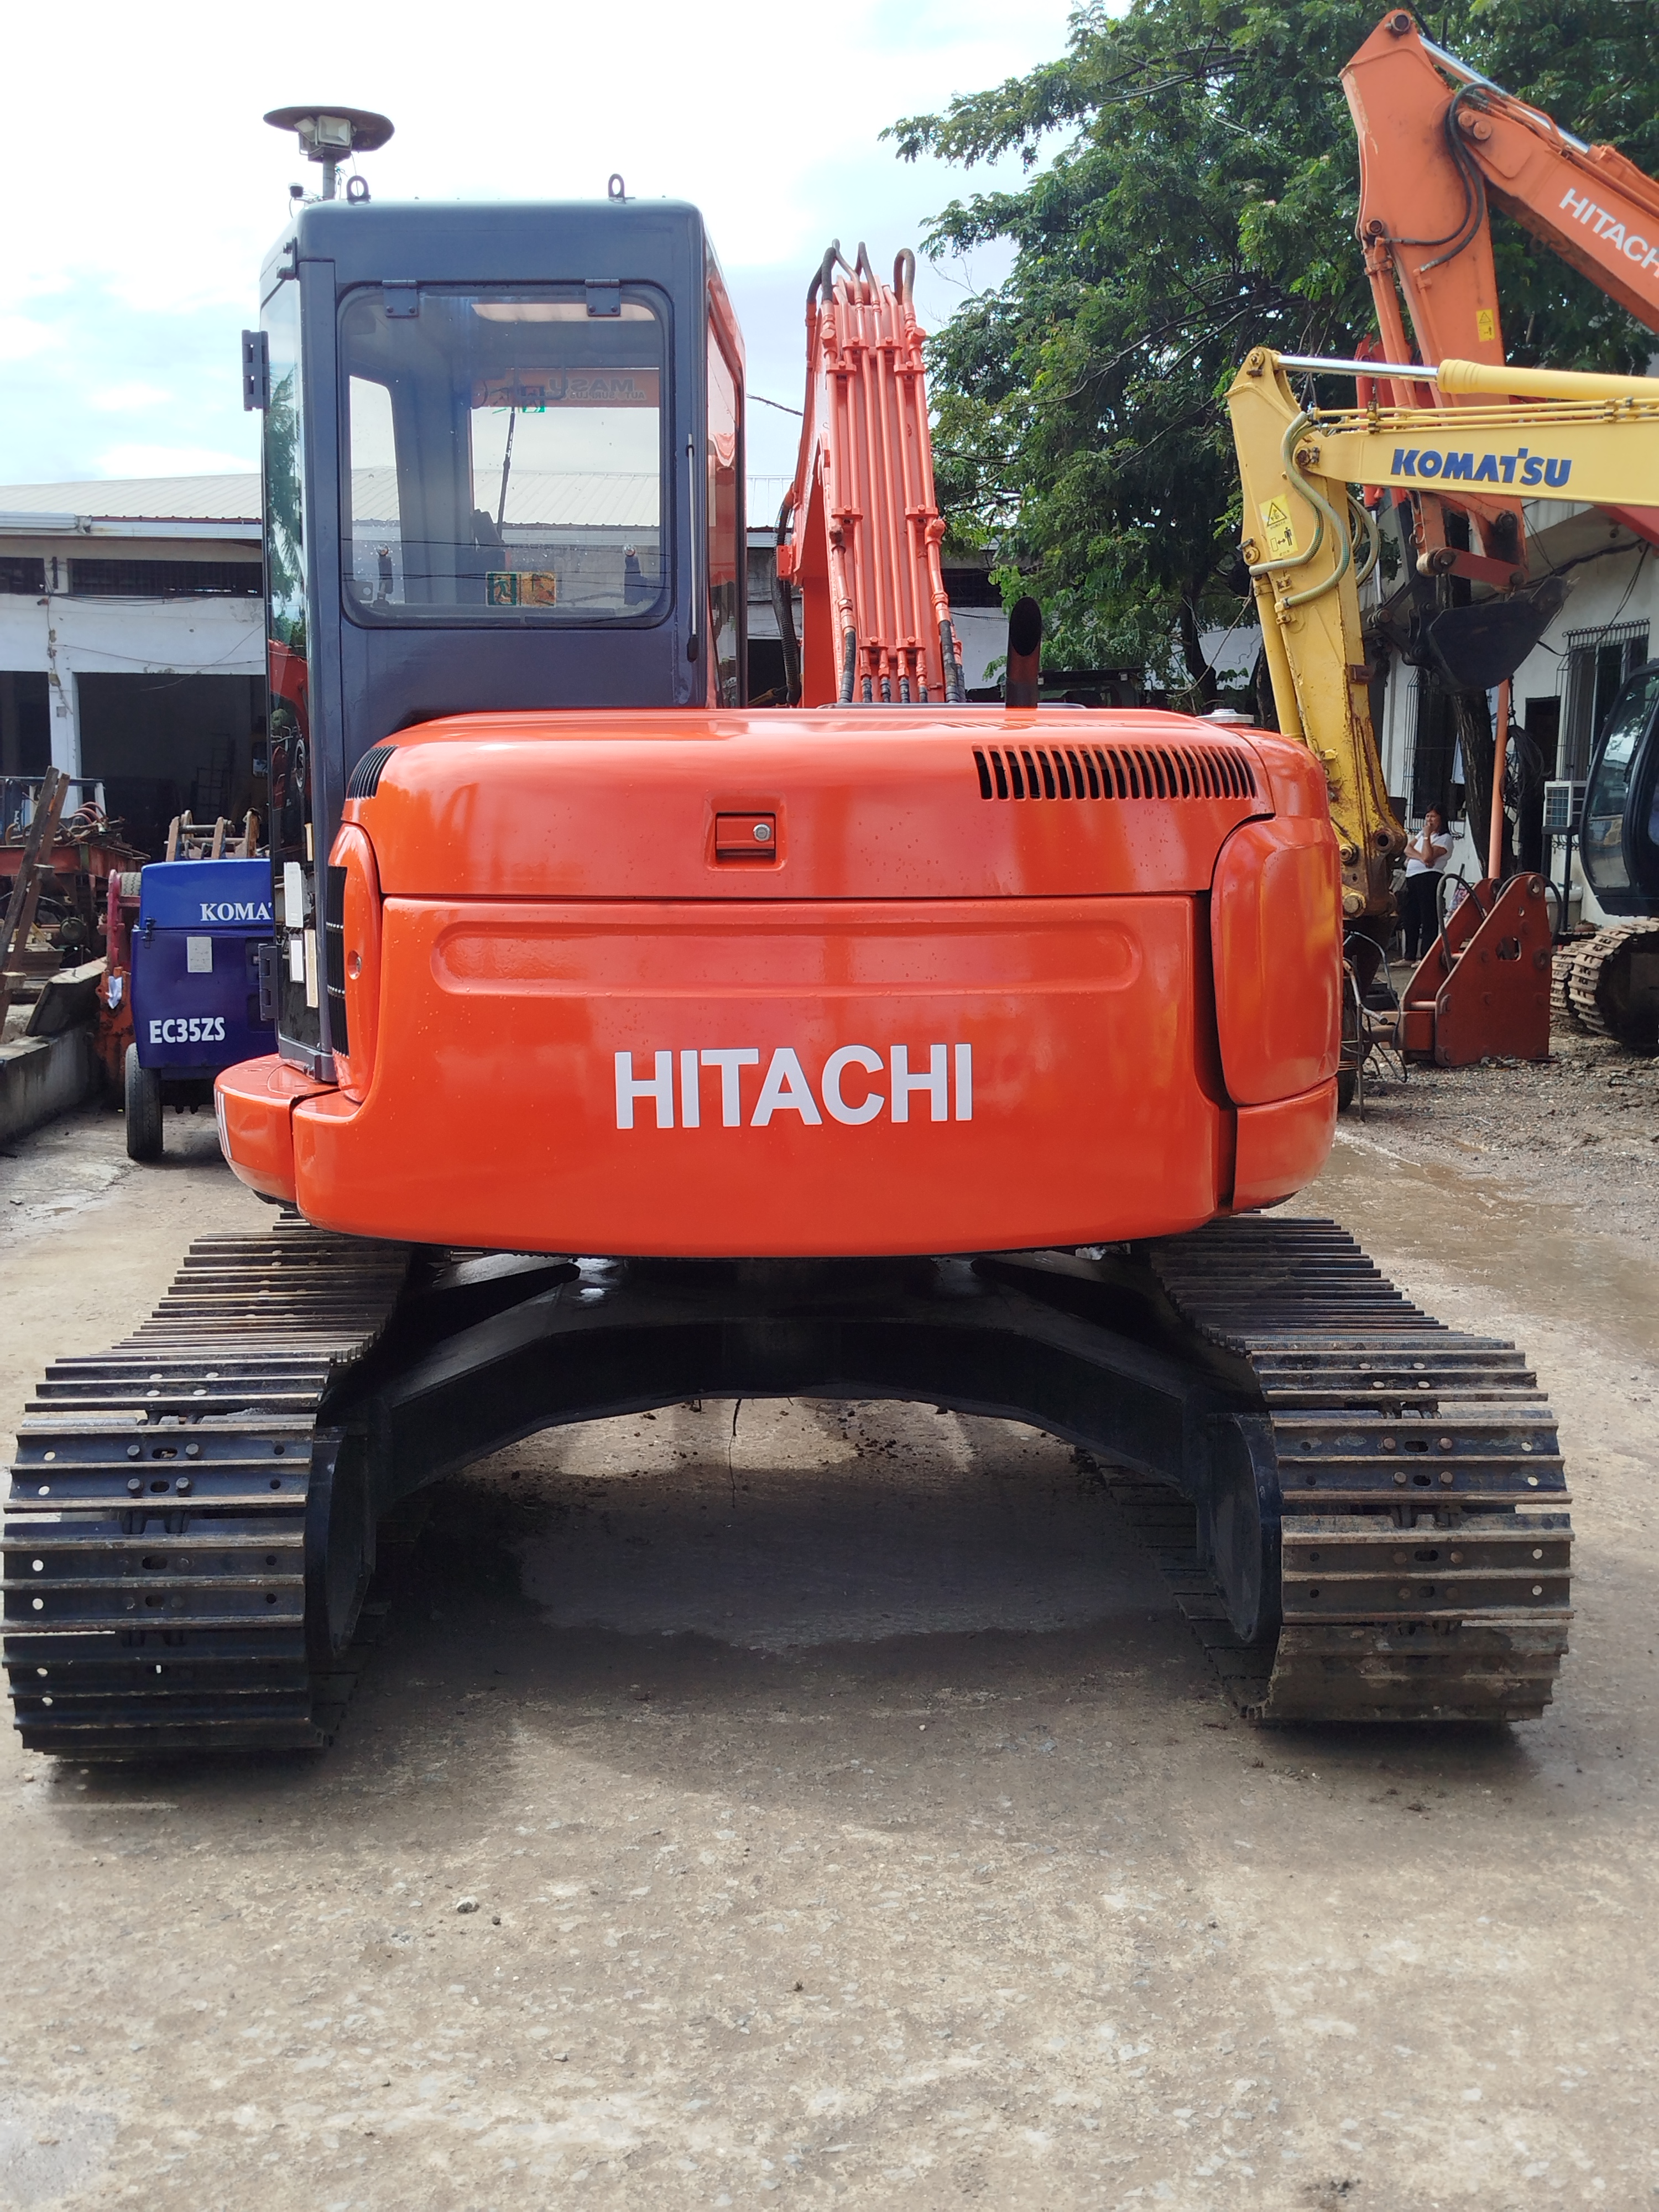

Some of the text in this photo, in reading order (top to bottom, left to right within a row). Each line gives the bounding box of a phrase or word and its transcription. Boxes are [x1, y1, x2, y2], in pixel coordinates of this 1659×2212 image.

[1390, 448, 1572, 487] KOMATSU
[149, 1017, 225, 1044] EC35ZS
[615, 1044, 972, 1129] HITACHI
